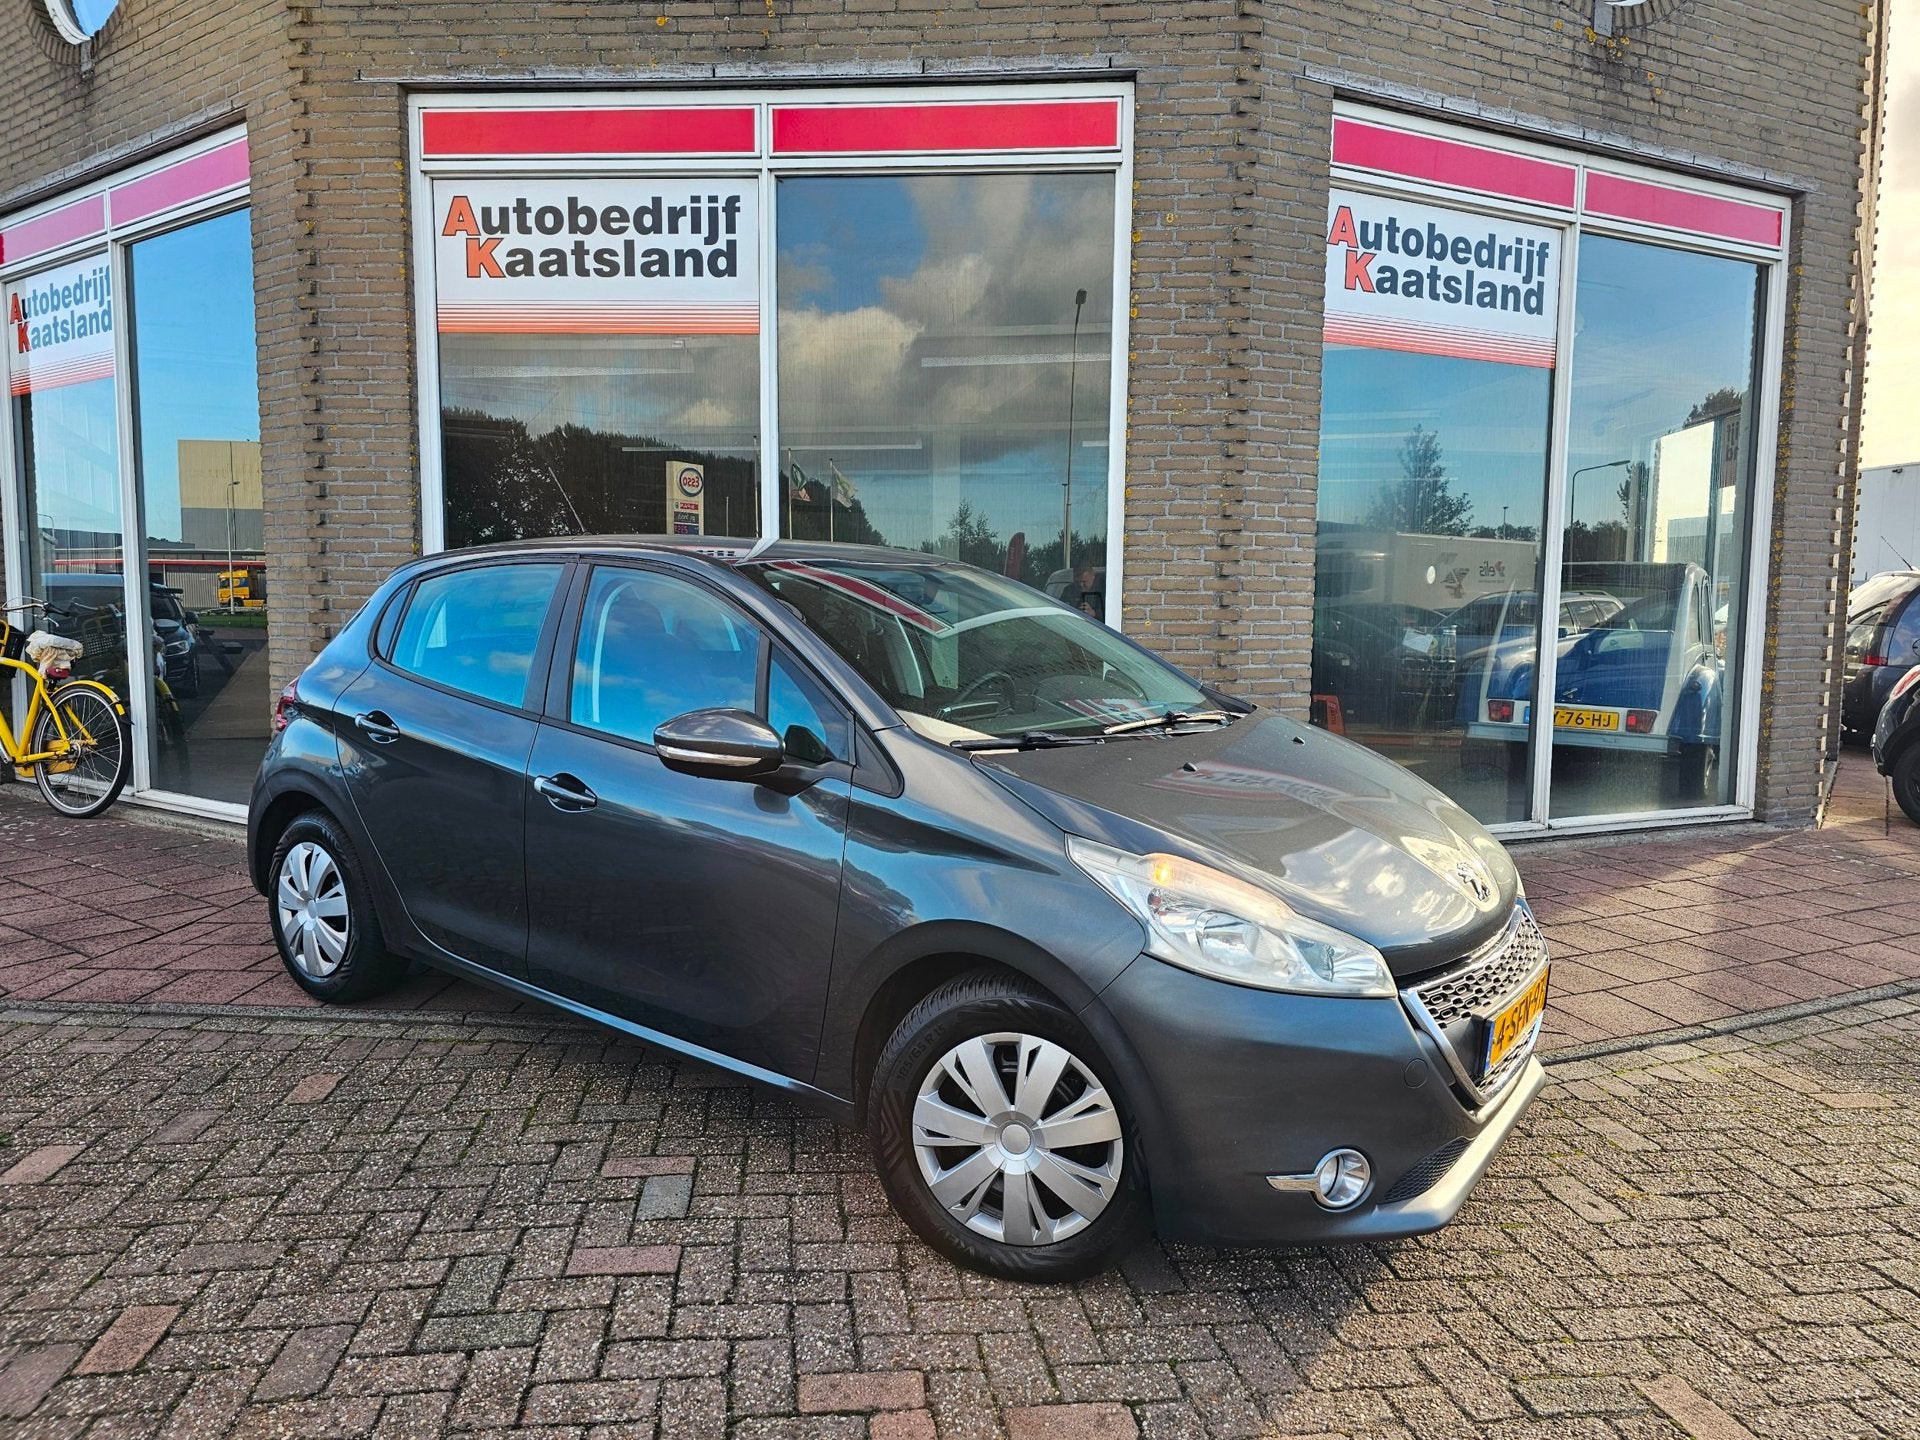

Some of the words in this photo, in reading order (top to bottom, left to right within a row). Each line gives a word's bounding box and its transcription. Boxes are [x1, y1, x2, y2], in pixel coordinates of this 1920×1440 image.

[442, 195, 741, 245] Autobedrijf
[1327, 205, 1549, 284] Autobedrijf
[465, 237, 738, 278] Kaatsland
[1344, 249, 1545, 316] Kaatsland
[10, 264, 111, 325] Autobedrijf
[18, 299, 112, 354] Kaatsland
[1553, 710, 1612, 727] Y-76-HJ
